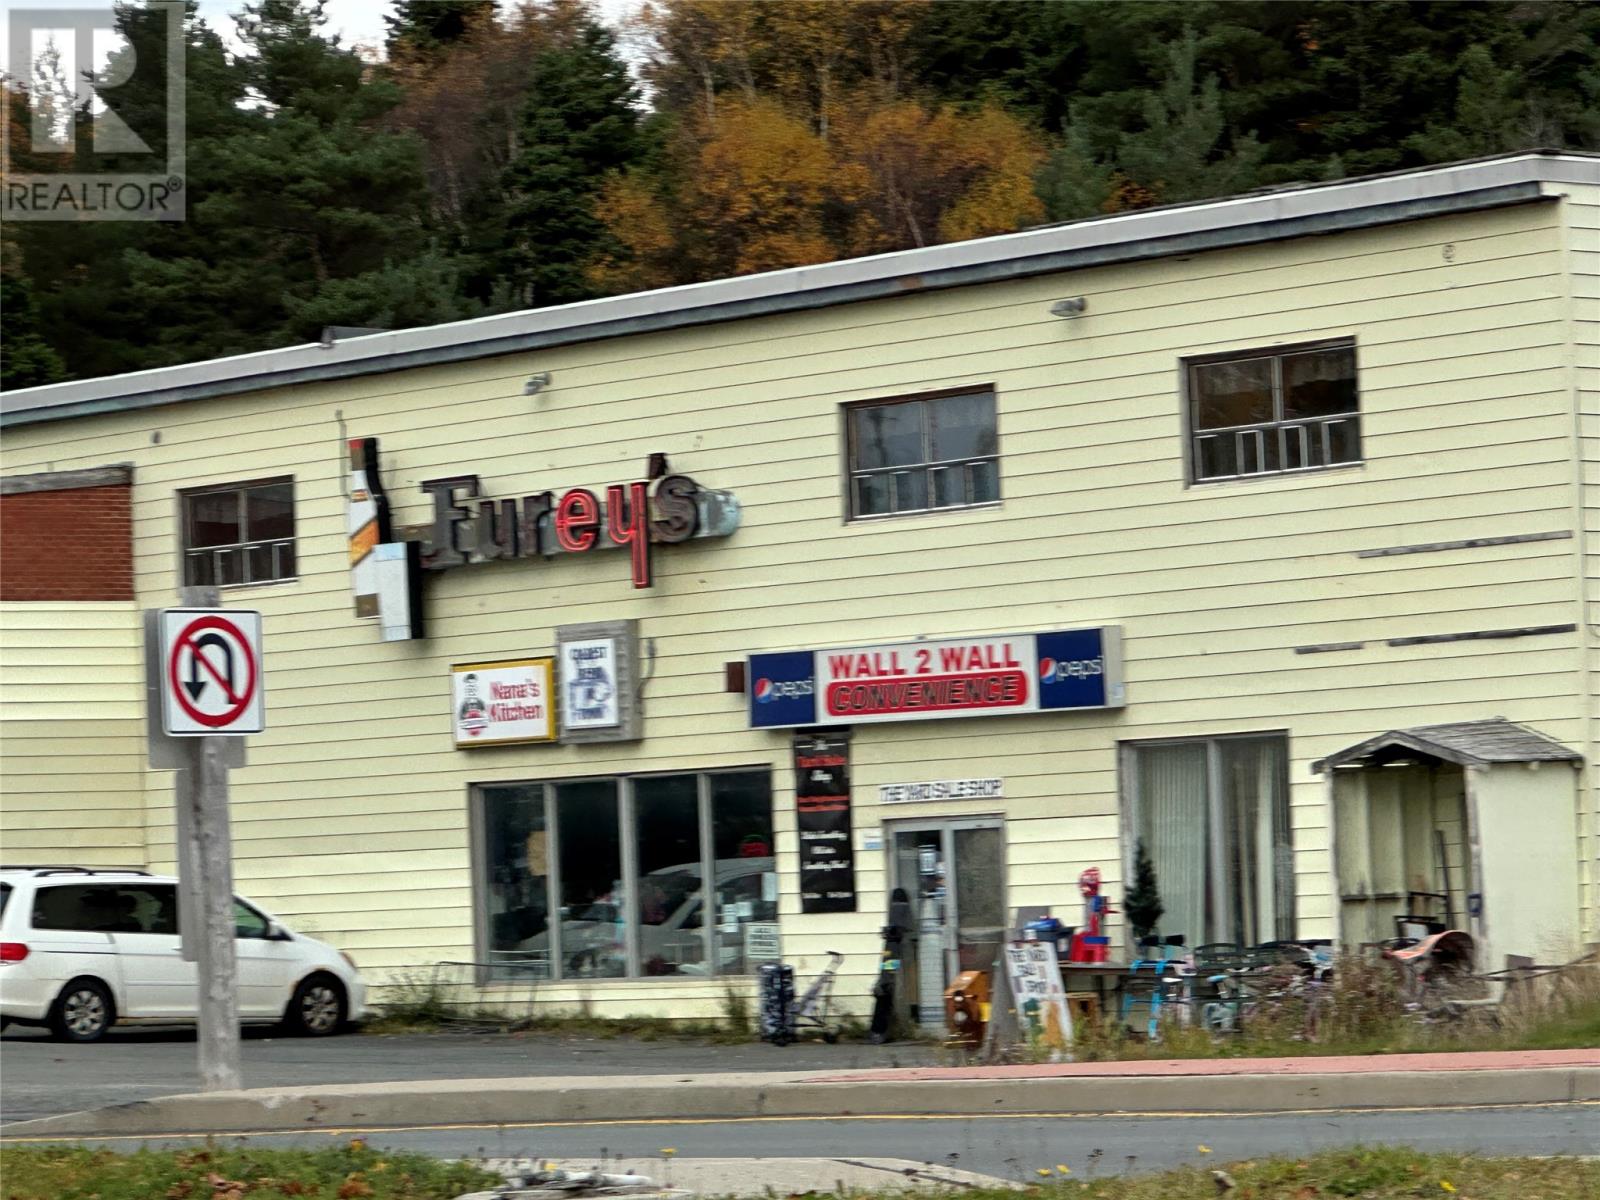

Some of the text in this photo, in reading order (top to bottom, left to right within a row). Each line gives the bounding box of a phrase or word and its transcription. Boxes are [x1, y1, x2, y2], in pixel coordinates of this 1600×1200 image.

[828, 643, 1020, 679] WALL 2 WALL
[490, 679, 541, 700] Nana's
[832, 674, 1019, 711] CONVENIENCE
[487, 702, 543, 722] Kitchen
[969, 779, 1001, 796] SHOP
